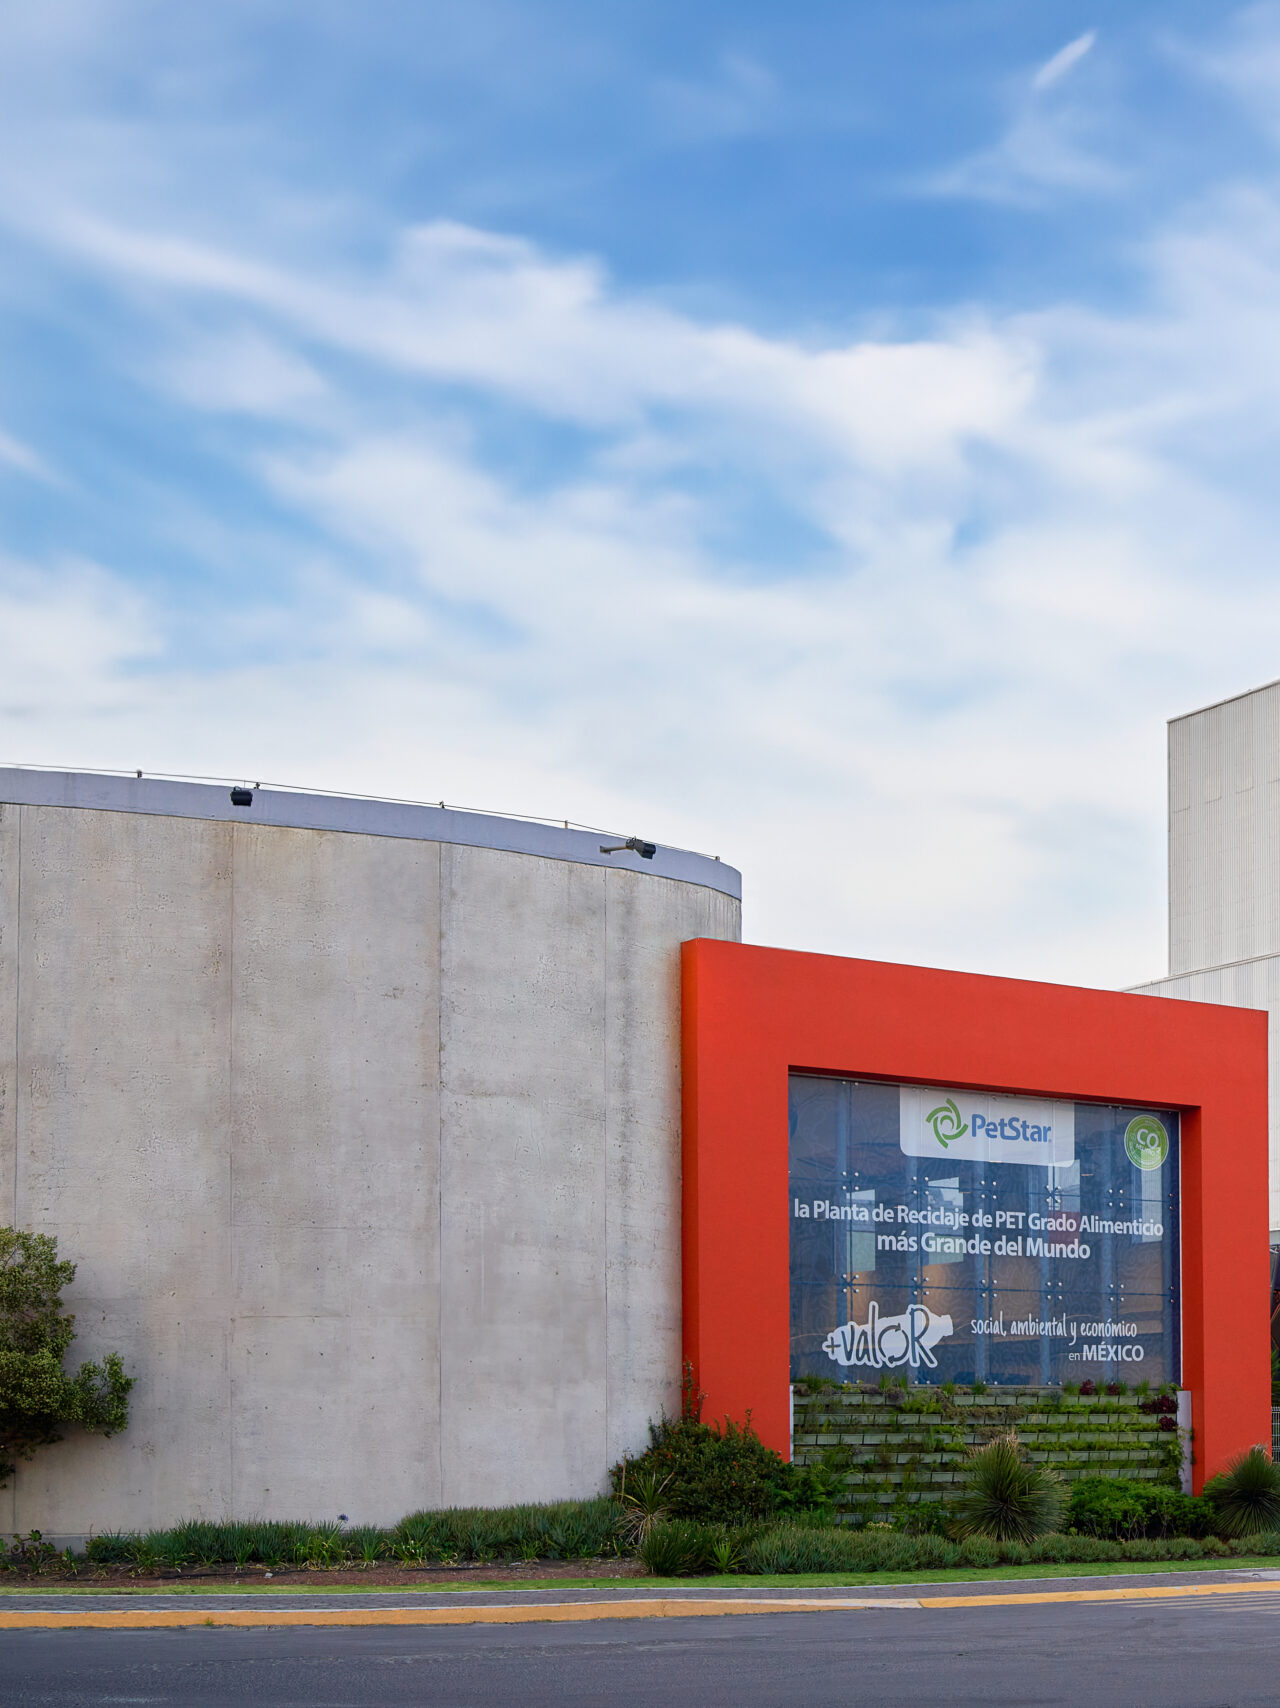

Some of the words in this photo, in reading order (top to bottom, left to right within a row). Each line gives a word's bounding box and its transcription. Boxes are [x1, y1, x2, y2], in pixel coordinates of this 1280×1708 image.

[972, 1113, 1052, 1142] PetStar
[795, 1198, 810, 1218] la
[814, 1200, 869, 1221] Planta
[872, 1203, 894, 1222] de
[897, 1205, 969, 1230] Reciclaje
[972, 1209, 992, 1228] de
[995, 1211, 1026, 1229] PET
[1028, 1213, 1077, 1232] Grado
[1079, 1214, 1164, 1237] Alimenticio
[877, 1230, 918, 1252] más
[921, 1232, 991, 1256] Grande
[994, 1235, 1023, 1257] del
[1026, 1237, 1091, 1259] Mundo
[1010, 1313, 1068, 1337] ambiental
[1068, 1320, 1077, 1346] y
[1080, 1318, 1138, 1338] económico
[1068, 1351, 1081, 1361] en
[1082, 1341, 1145, 1362] MÉXICO
